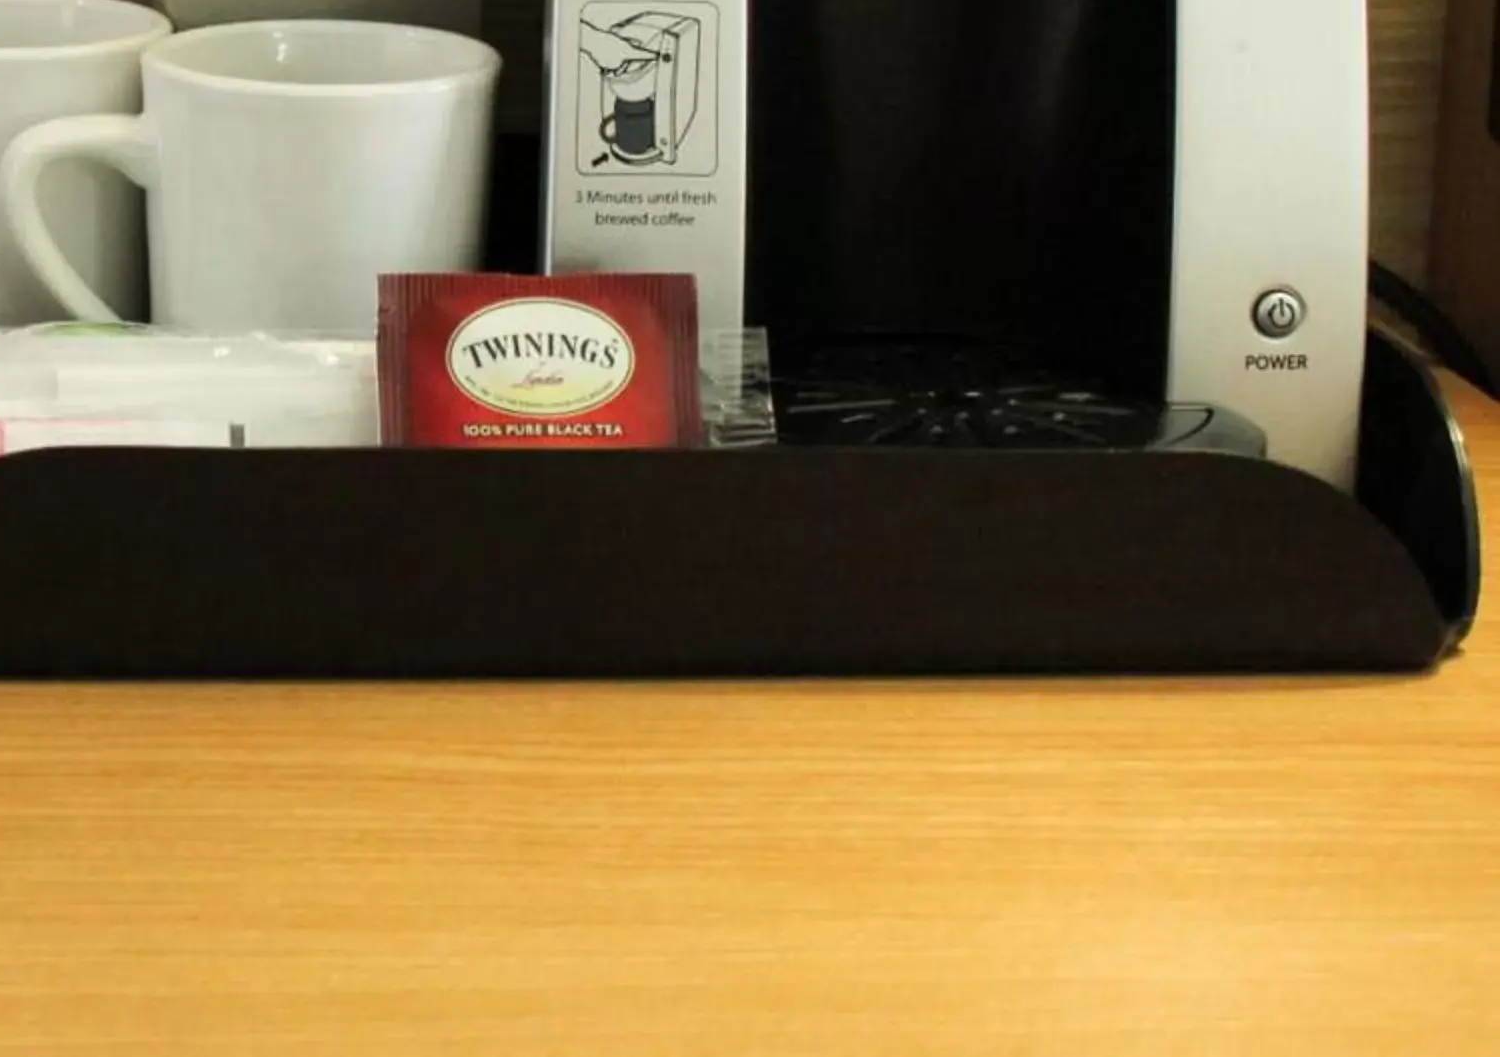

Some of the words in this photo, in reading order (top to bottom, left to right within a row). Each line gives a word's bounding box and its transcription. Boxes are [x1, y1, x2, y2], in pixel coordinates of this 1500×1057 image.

[587, 190, 644, 205] Minutes
[647, 190, 679, 205] until
[682, 190, 717, 206] fresh
[595, 211, 649, 226] brewed
[651, 211, 696, 226] coffee
[462, 332, 616, 369] TWININGS
[1245, 354, 1308, 370] POWER
[463, 425, 500, 437] 100%
[506, 424, 542, 436] PURE
[548, 424, 592, 436] BLACK
[597, 424, 623, 436] TEA
